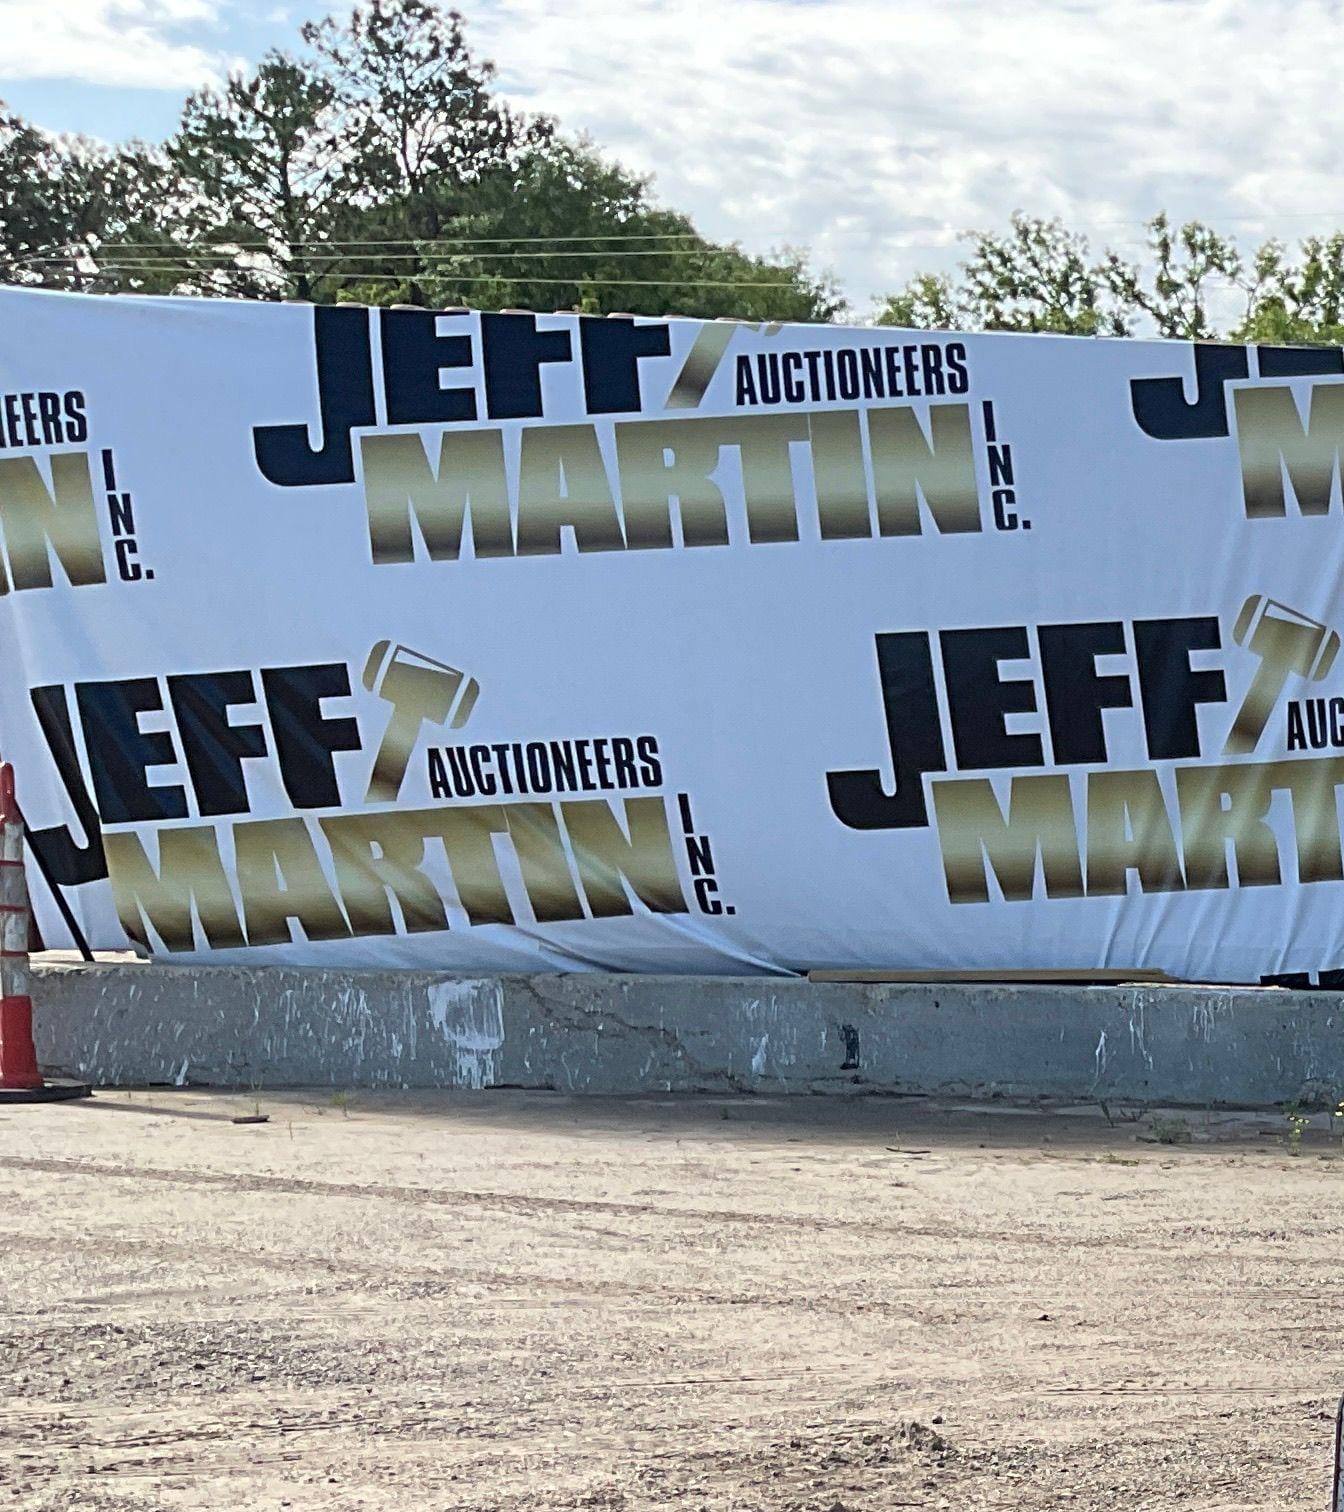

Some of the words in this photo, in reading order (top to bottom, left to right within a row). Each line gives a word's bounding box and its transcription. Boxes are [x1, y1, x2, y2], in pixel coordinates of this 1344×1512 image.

[735, 343, 969, 405] AUCTIONEERS
[102, 449, 154, 582] INC.
[361, 404, 983, 565] MARTIN
[983, 400, 1031, 531] INC.
[30, 663, 361, 886] JEFF
[428, 736, 664, 800] AUCTIONEERS
[826, 617, 1227, 830] JEFF
[104, 796, 688, 954] MARTIN
[678, 793, 735, 915] INC.
